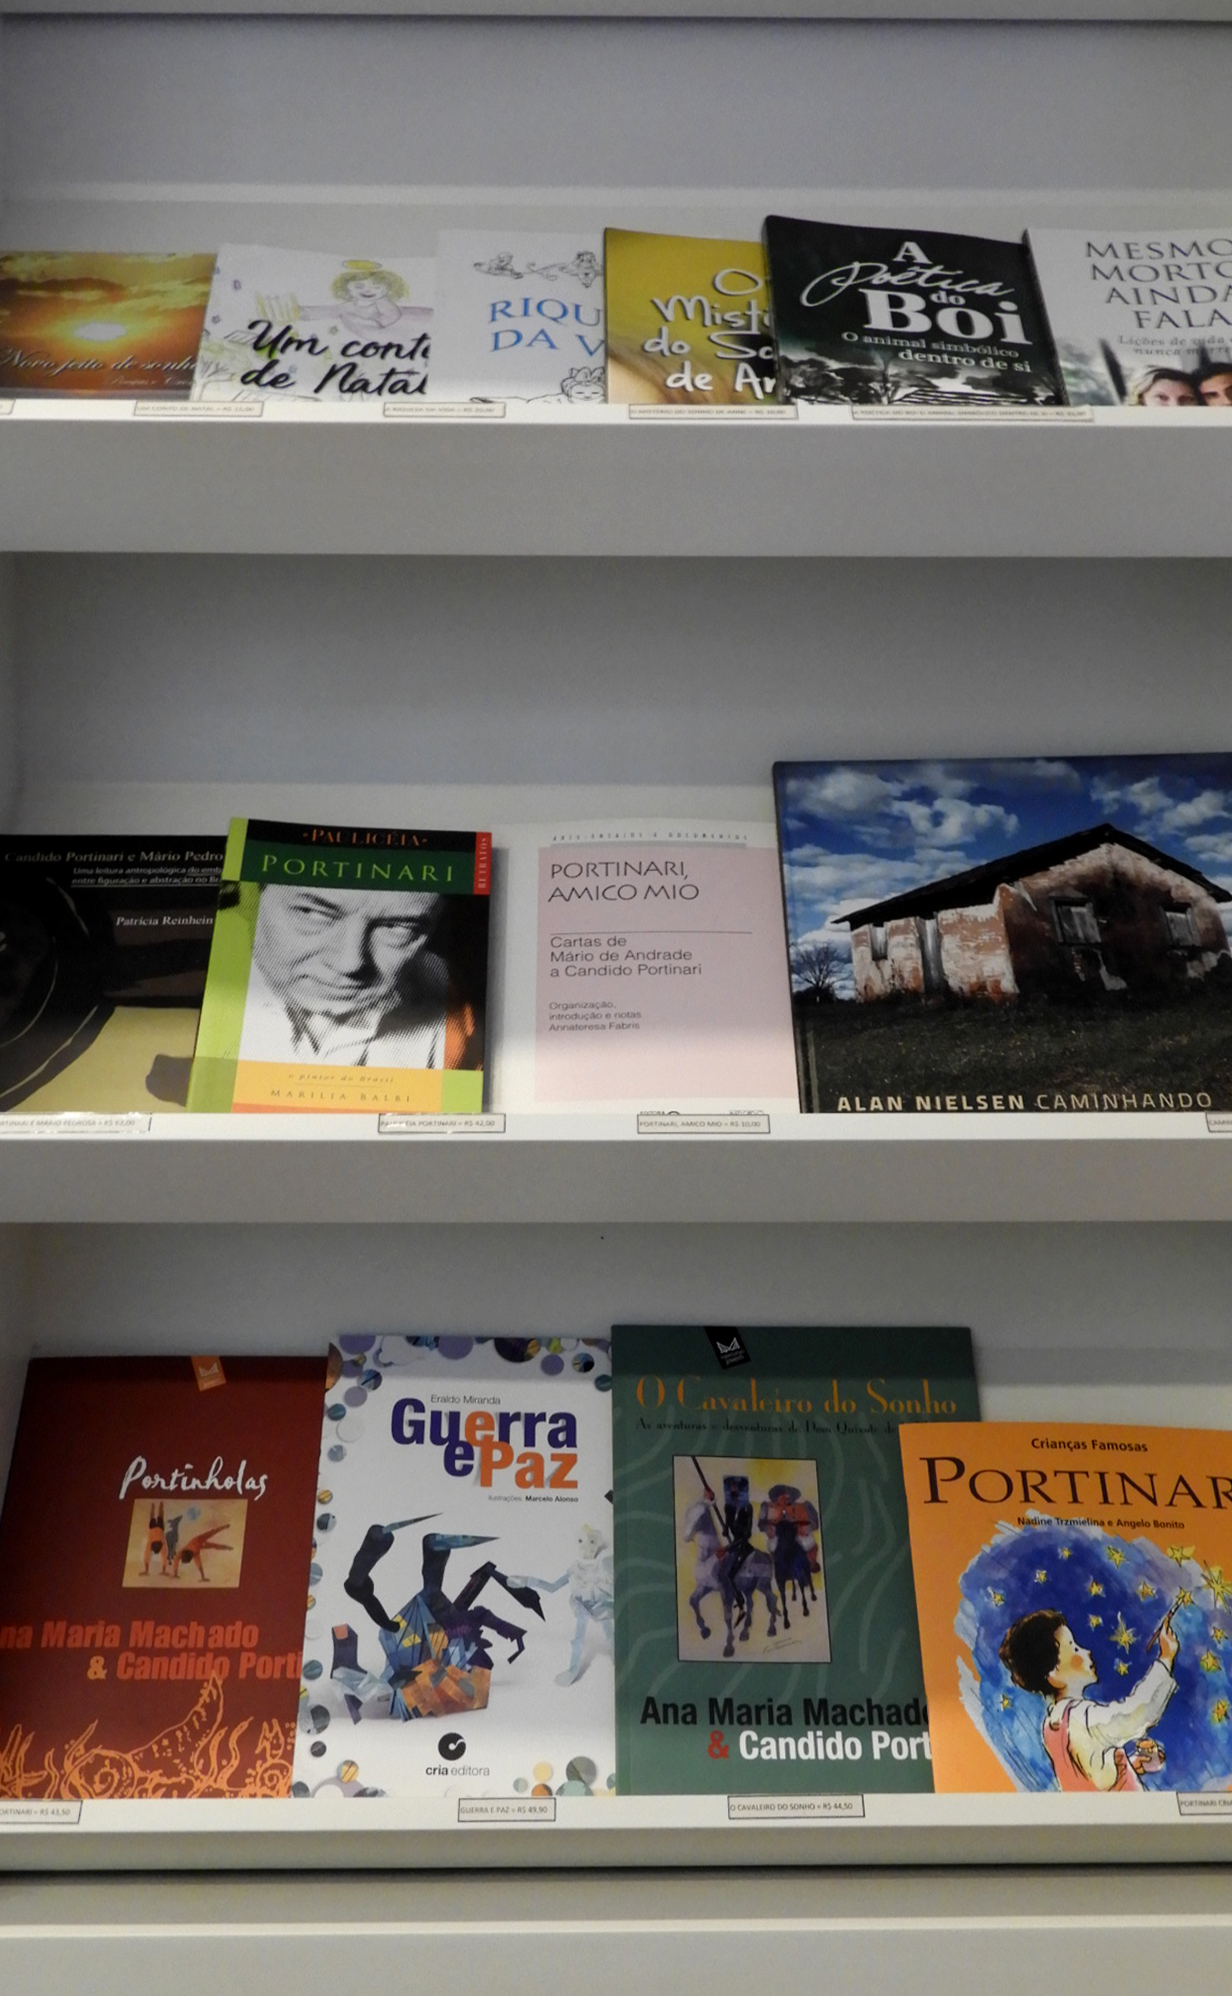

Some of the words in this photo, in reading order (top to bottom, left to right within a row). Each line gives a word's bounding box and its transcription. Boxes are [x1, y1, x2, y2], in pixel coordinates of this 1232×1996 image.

[892, 241, 933, 264] A
[1085, 238, 1232, 260] MESMO
[713, 268, 764, 296] O
[801, 261, 1015, 307] Poética
[929, 290, 967, 306] do
[858, 288, 1033, 345] Boi
[1134, 309, 1232, 329] FALA
[248, 319, 329, 359] Um
[491, 329, 559, 352] DA
[643, 326, 691, 357] do
[841, 331, 858, 343] O
[862, 335, 926, 349] animal
[930, 341, 1019, 358] simbólico
[1118, 335, 1165, 347] Lições
[1170, 336, 1189, 347] de
[898, 350, 976, 367] dentro
[980, 357, 1008, 370] de
[1013, 362, 1031, 373] si
[240, 359, 296, 388] de
[666, 361, 714, 392] de
[4, 851, 62, 863] Candido
[65, 851, 124, 863] Portinari
[127, 853, 136, 862] e
[140, 850, 181, 862] Mário
[185, 850, 223, 862] Pedro
[95, 867, 123, 875] leitura
[125, 866, 186, 876] antropológica
[188, 866, 199, 874] do
[261, 854, 453, 882] PORTINARI
[550, 861, 689, 880] PORTINARI,
[98, 877, 140, 887] figuração
[149, 876, 194, 886] abstração
[548, 884, 638, 902] AMICO
[643, 884, 700, 900] MIO
[116, 916, 159, 927] Patrícia
[550, 936, 602, 948] Cartas
[607, 935, 627, 947] de
[550, 950, 594, 962] Mário
[600, 950, 619, 962] de
[624, 949, 692, 961] Andrade
[550, 967, 560, 977] a
[565, 964, 632, 977] Candido
[638, 963, 702, 976] Portinari
[549, 1011, 603, 1021] introdução
[614, 1011, 642, 1020] notas
[549, 1023, 606, 1032] Annateresa
[608, 1021, 640, 1031] Fabris
[837, 1096, 903, 1112] ALAN
[915, 1095, 1025, 1111] NIELSEN
[1037, 1092, 1213, 1111] CAMINHANDO
[430, 1394, 461, 1405] Eraldo
[463, 1395, 501, 1405] Miranda
[636, 1374, 666, 1410] O
[677, 1374, 813, 1414] Cavaleiro
[824, 1379, 857, 1414] do
[866, 1378, 957, 1415] Sonho
[391, 1397, 578, 1449] Guerra
[1031, 1438, 1088, 1452] Crianças
[1091, 1439, 1148, 1452] Famosas
[443, 1439, 475, 1477] e
[480, 1434, 578, 1489] Paz
[118, 1454, 268, 1501] Portinholas
[919, 1456, 1232, 1510] PORTINAR
[525, 1495, 553, 1503] Marcelo
[1017, 1516, 1053, 1527] Nadine
[1055, 1517, 1105, 1528] Trzmielina
[1116, 1517, 1151, 1530] Angelo
[1153, 1518, 1185, 1530] Bonito
[40, 1620, 122, 1648] Maria
[129, 1620, 259, 1649] Machado
[87, 1656, 108, 1680] &
[116, 1651, 230, 1680] Candido
[640, 1696, 698, 1726] Ana
[708, 1697, 793, 1726] Maria
[707, 1729, 730, 1760] &
[739, 1730, 862, 1760] Candido
[425, 1764, 449, 1776] cria
[451, 1764, 490, 1776] editora
[790, 1803, 815, 1811] SONHO
